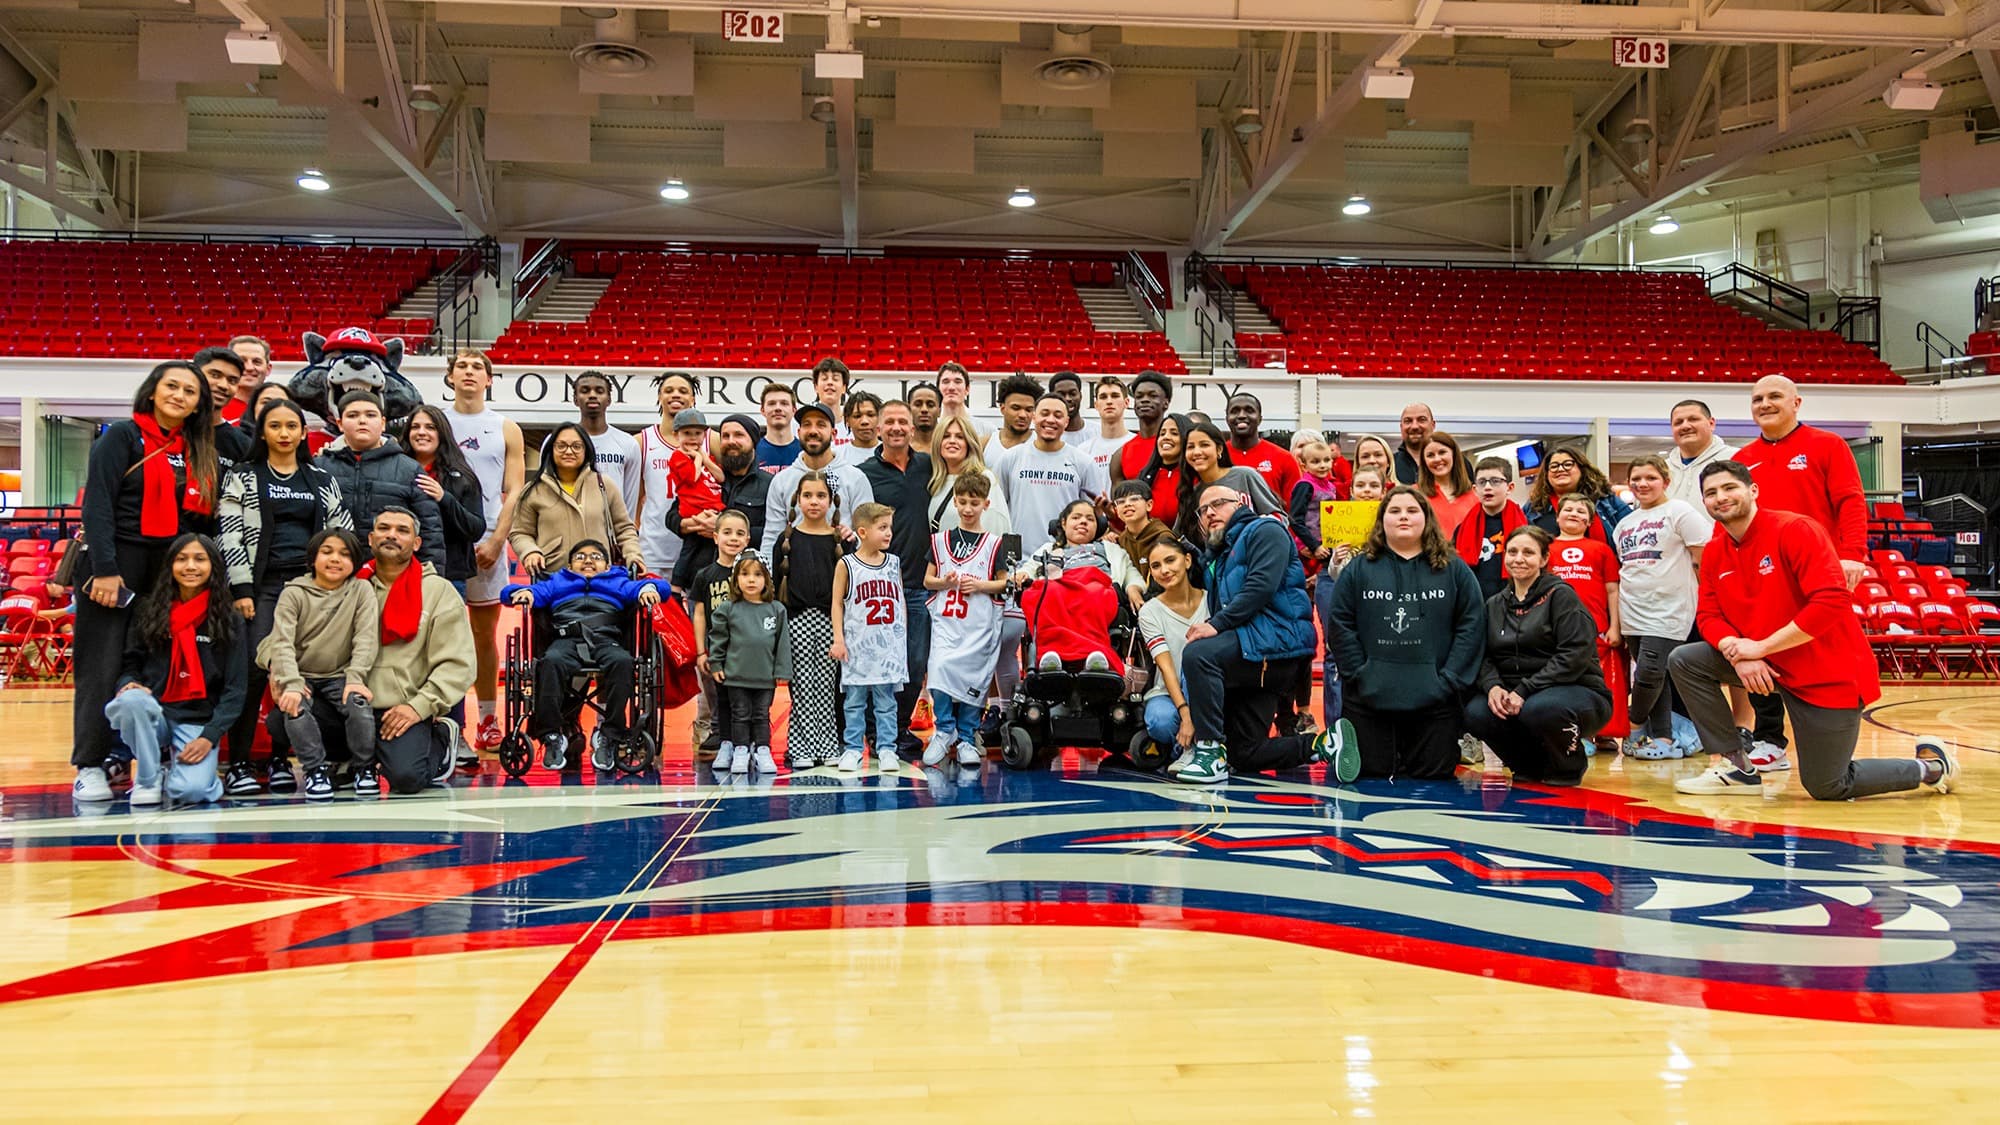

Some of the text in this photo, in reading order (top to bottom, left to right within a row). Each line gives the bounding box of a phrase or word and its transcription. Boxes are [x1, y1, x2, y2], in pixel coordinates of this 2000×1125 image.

[735, 15, 780, 38] 202
[1624, 42, 1666, 64] 203
[1019, 470, 1075, 483] STONY BROOK
[268, 490, 315, 500] uchenn
[1337, 504, 1353, 516] GO
[1962, 534, 1977, 543] 103
[1362, 589, 1446, 602] LONG ISLAND
[942, 590, 969, 619] 25
[865, 599, 895, 625] 23
